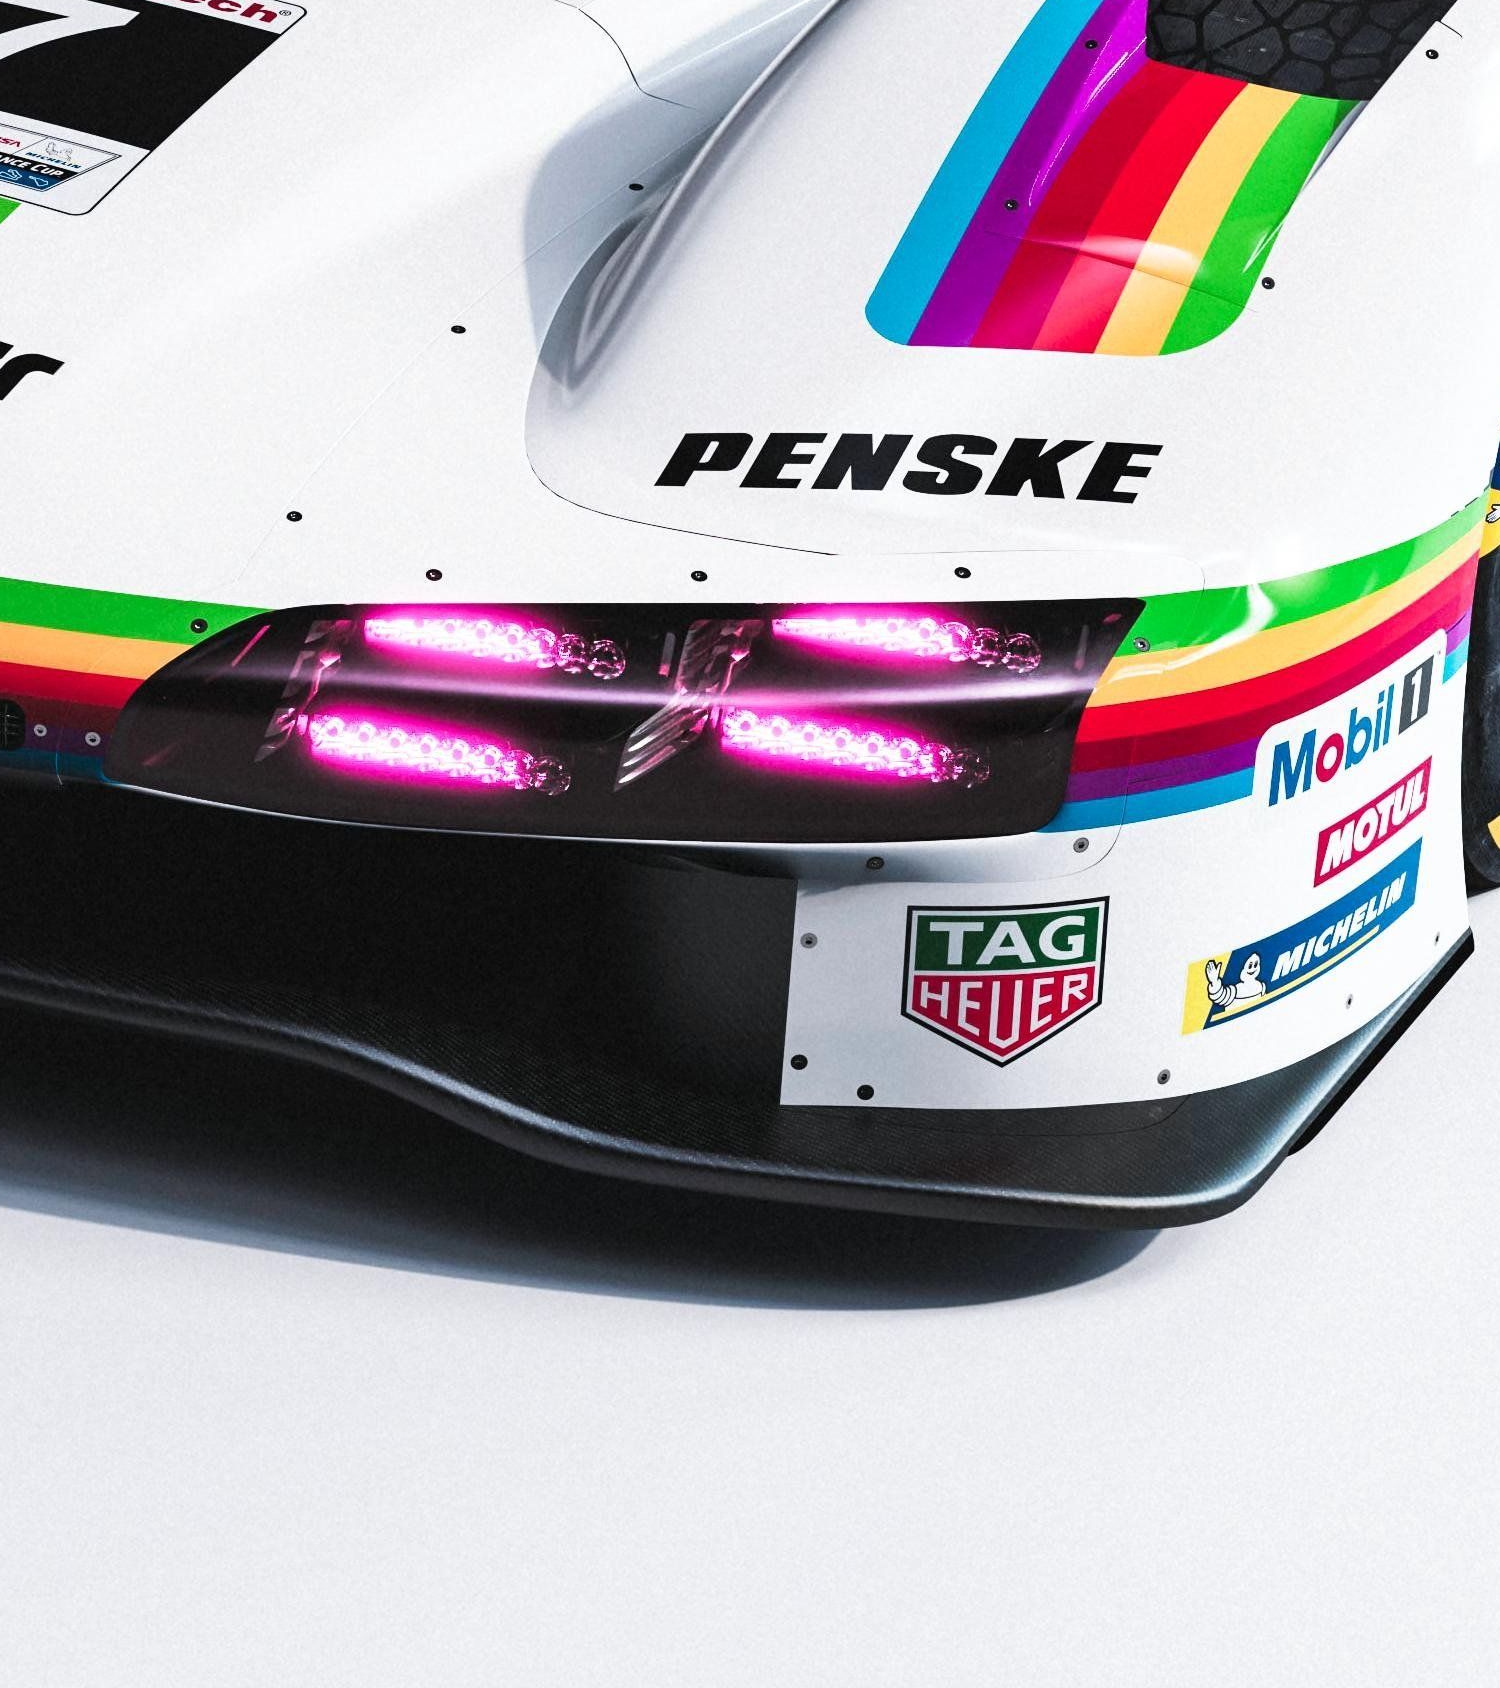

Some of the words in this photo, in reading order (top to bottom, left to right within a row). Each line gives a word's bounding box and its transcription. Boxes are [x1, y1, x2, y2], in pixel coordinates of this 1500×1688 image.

[24, 150, 84, 170] MICHELIN
[31, 163, 64, 178] CUP
[653, 431, 1165, 505] PENSKE
[1268, 682, 1395, 808] Mobil
[1319, 772, 1426, 878] MOTUL
[928, 915, 1087, 967] TAG
[1270, 871, 1407, 983] MICHELIN
[920, 971, 1092, 1052] HEUER
